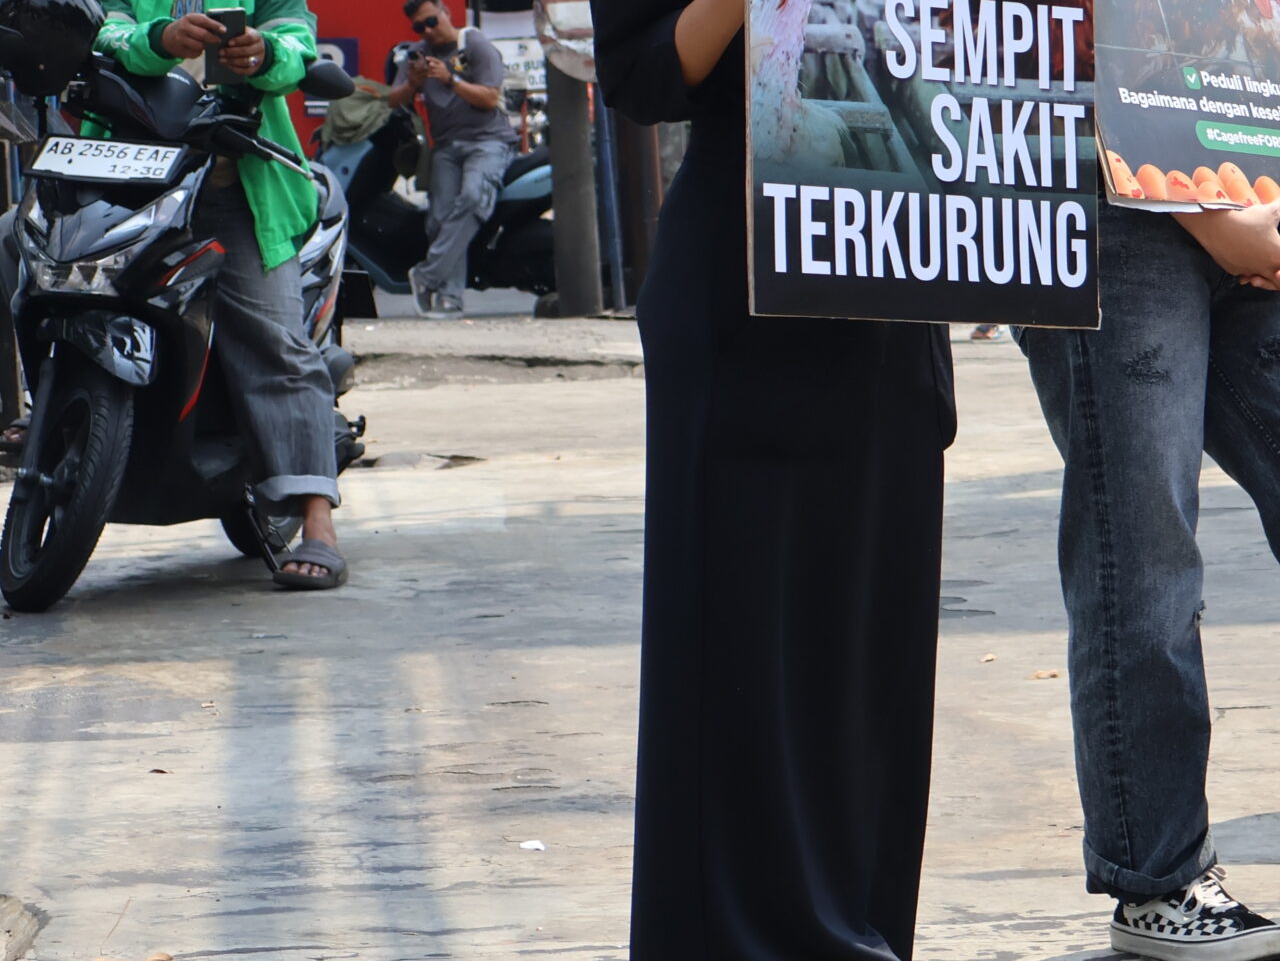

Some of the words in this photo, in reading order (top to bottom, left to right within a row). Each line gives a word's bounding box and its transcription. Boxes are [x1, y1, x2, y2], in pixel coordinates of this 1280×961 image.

[1200, 70, 1242, 92] Peduli
[1118, 87, 1198, 111] Bagaimana
[1199, 97, 1250, 118] dengan
[46, 141, 75, 156] AB
[78, 143, 131, 159] 2556
[133, 147, 176, 163] EAF
[930, 93, 1085, 189] SAKIT
[763, 182, 1087, 288] TERKURUNG
